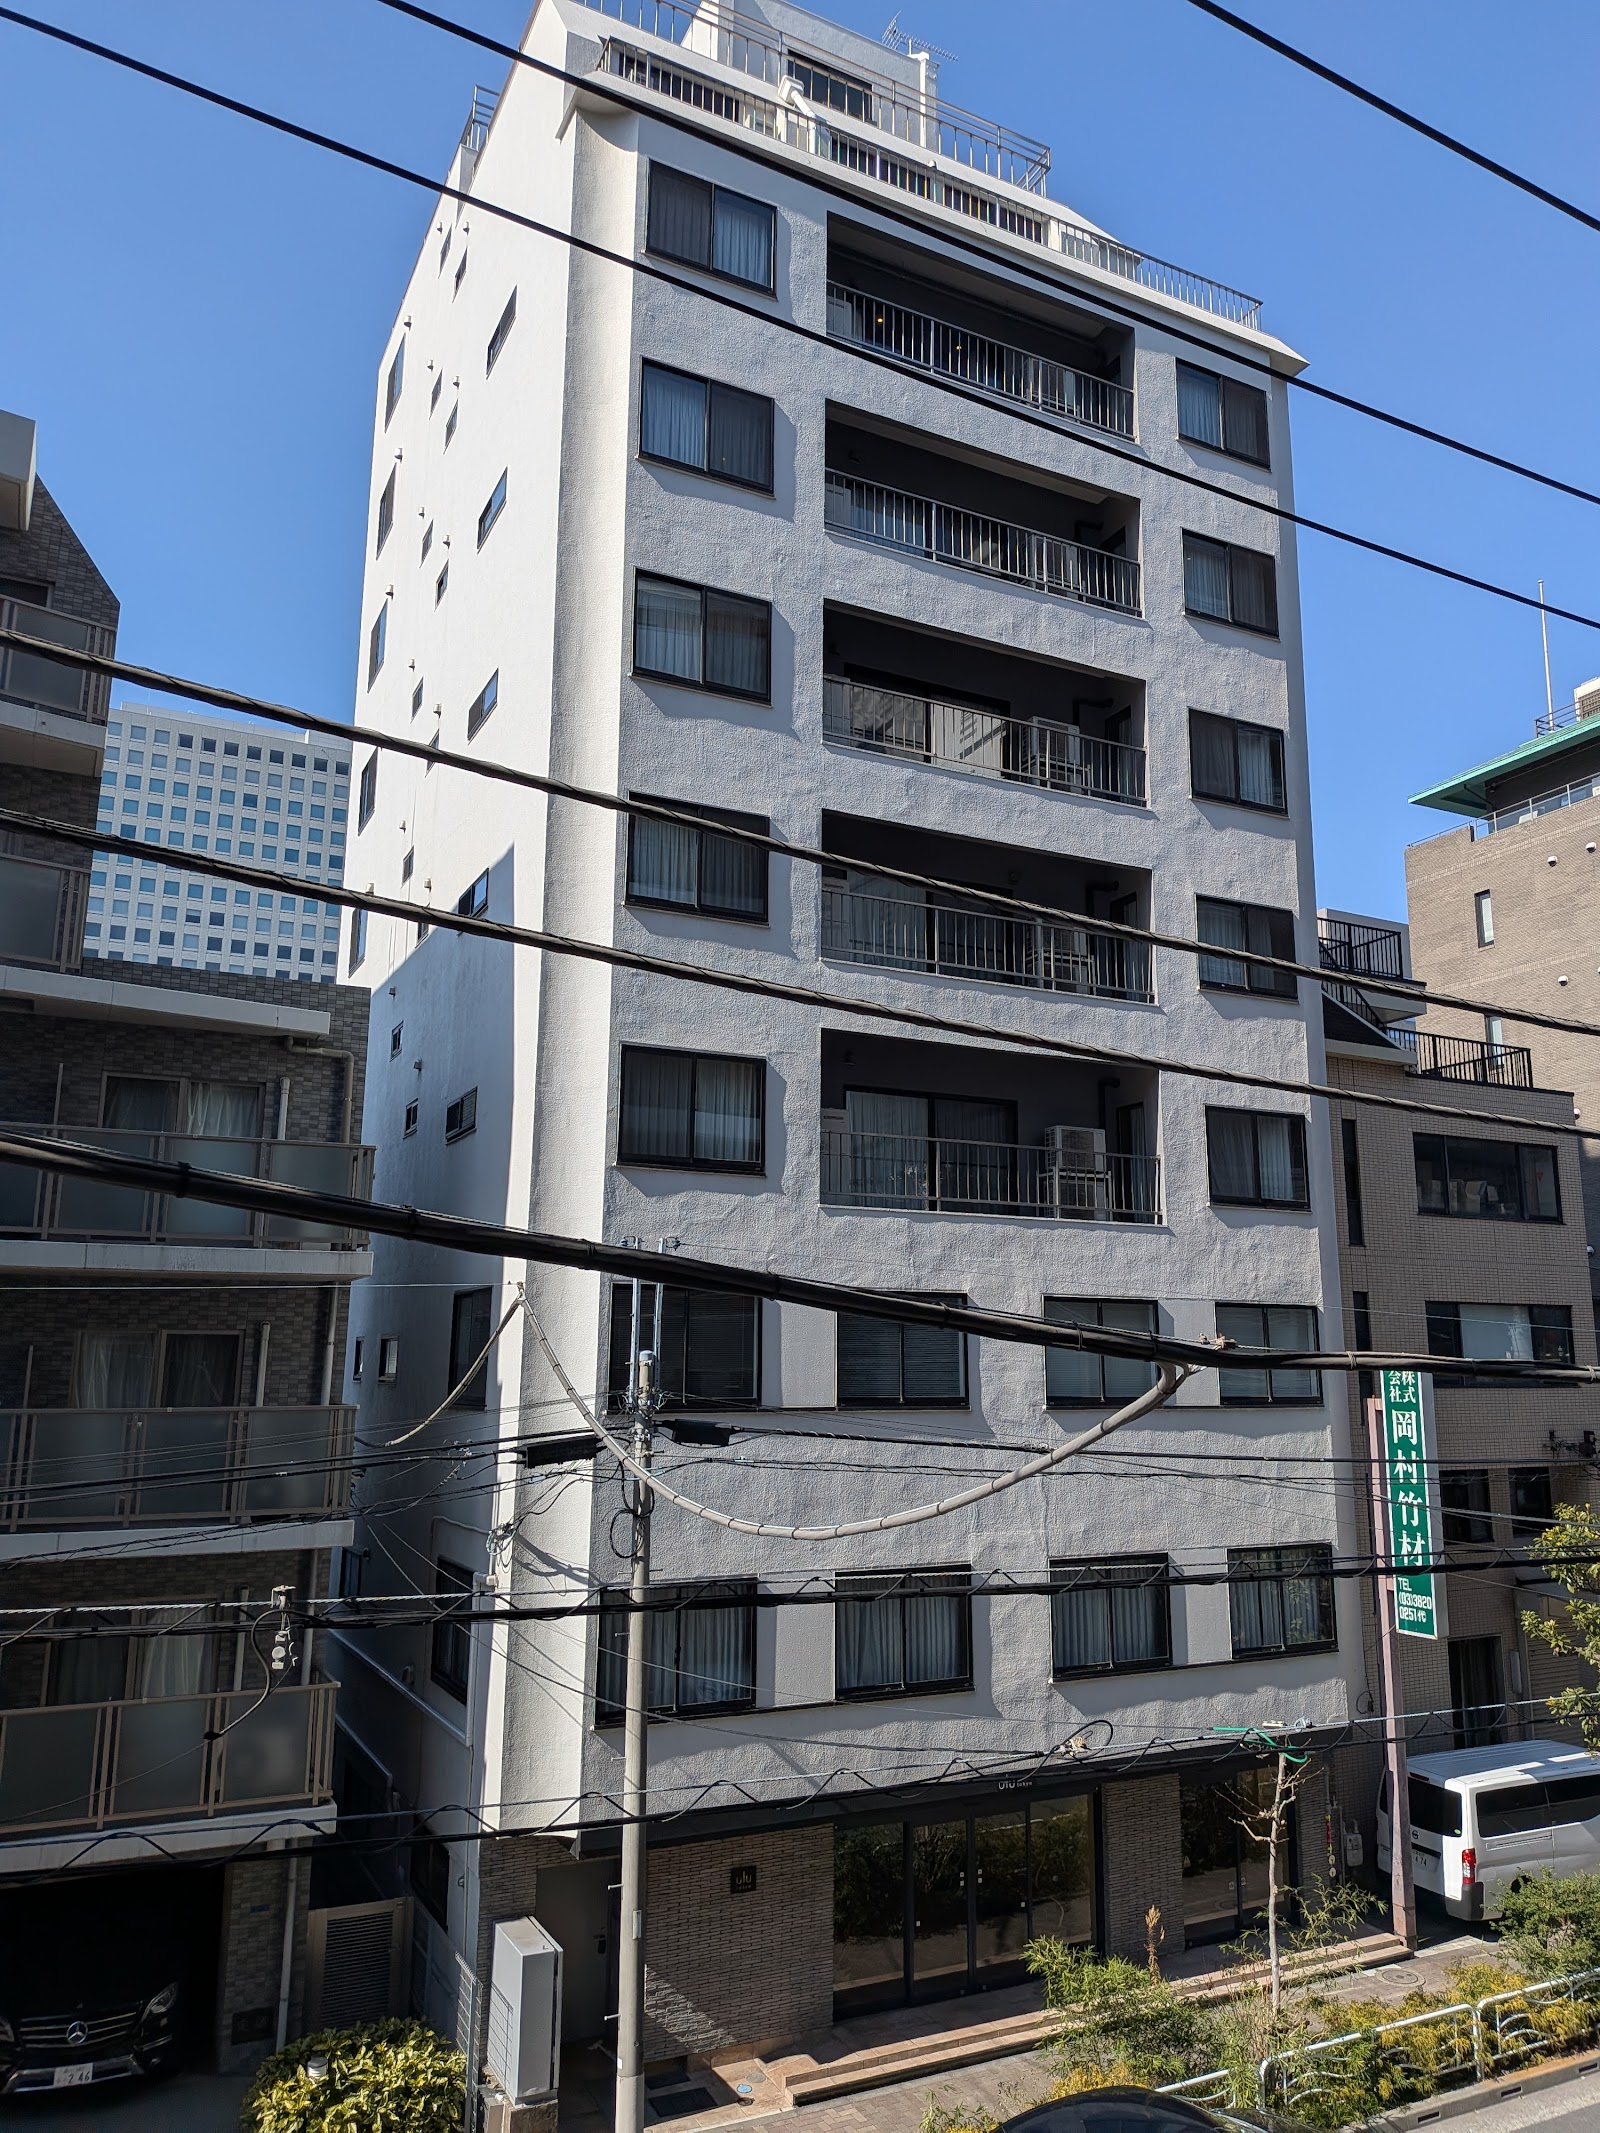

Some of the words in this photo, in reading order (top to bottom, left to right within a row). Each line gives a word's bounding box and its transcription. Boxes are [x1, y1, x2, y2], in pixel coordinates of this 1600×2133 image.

[1391, 1409, 1426, 1567] 岡村竹材
[1397, 1577, 1412, 1591] TEL
[735, 1870, 752, 1885] ulu
